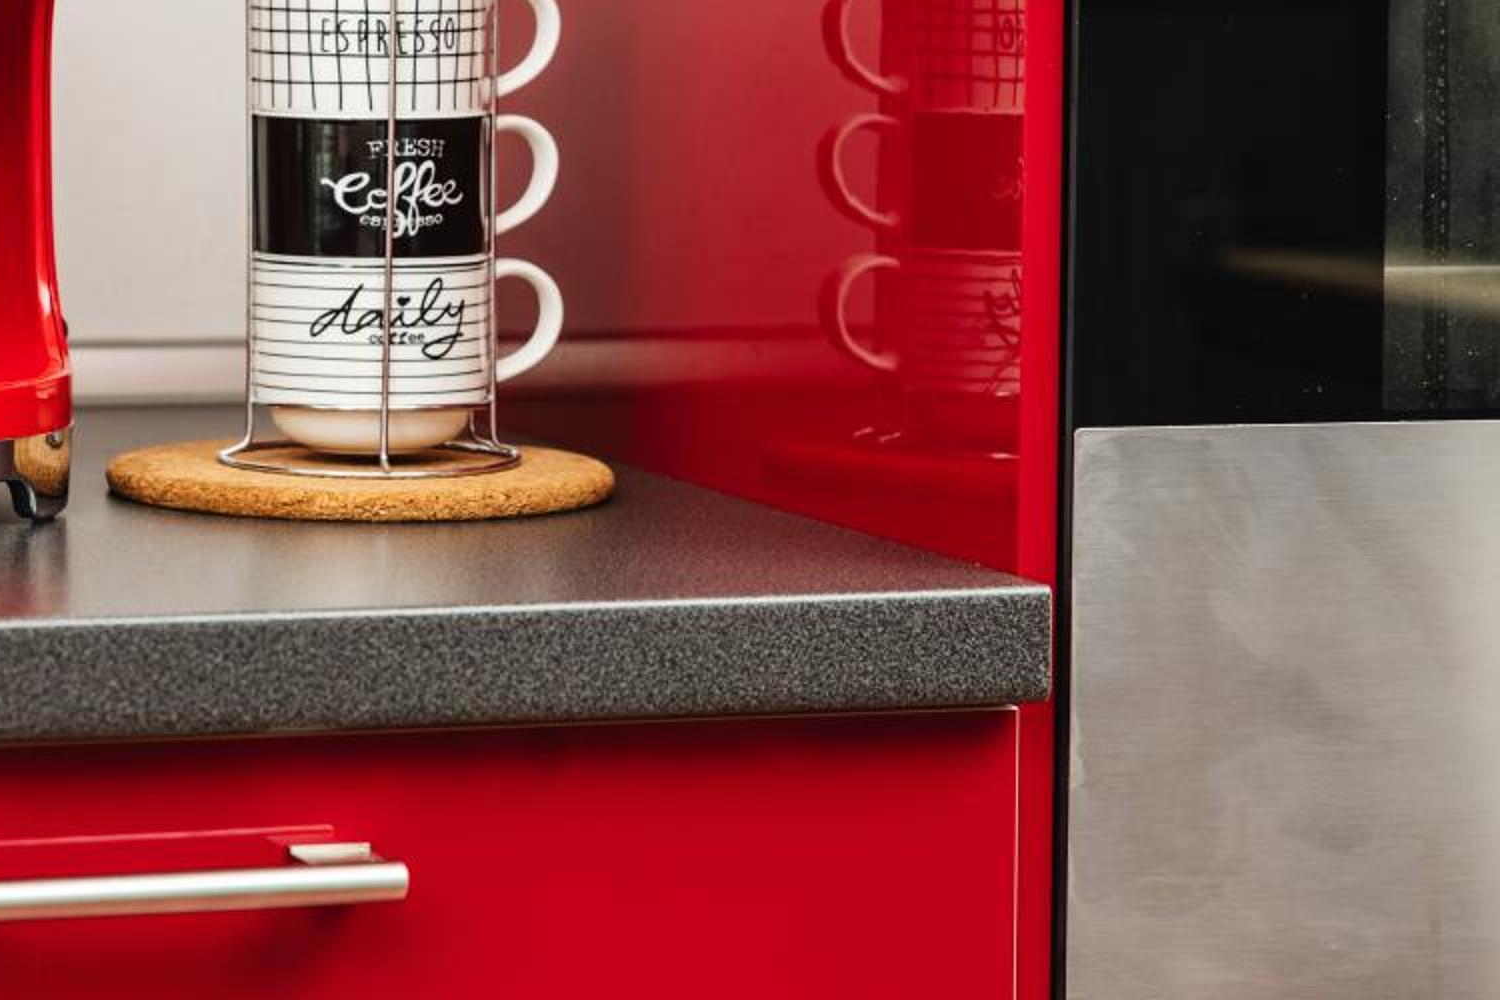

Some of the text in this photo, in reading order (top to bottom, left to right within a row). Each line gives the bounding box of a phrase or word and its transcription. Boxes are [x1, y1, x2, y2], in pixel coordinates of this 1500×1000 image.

[320, 17, 456, 55] ESPRESSO
[366, 138, 446, 158] FRESH
[320, 160, 464, 239] Coffee
[310, 278, 465, 360] daily
